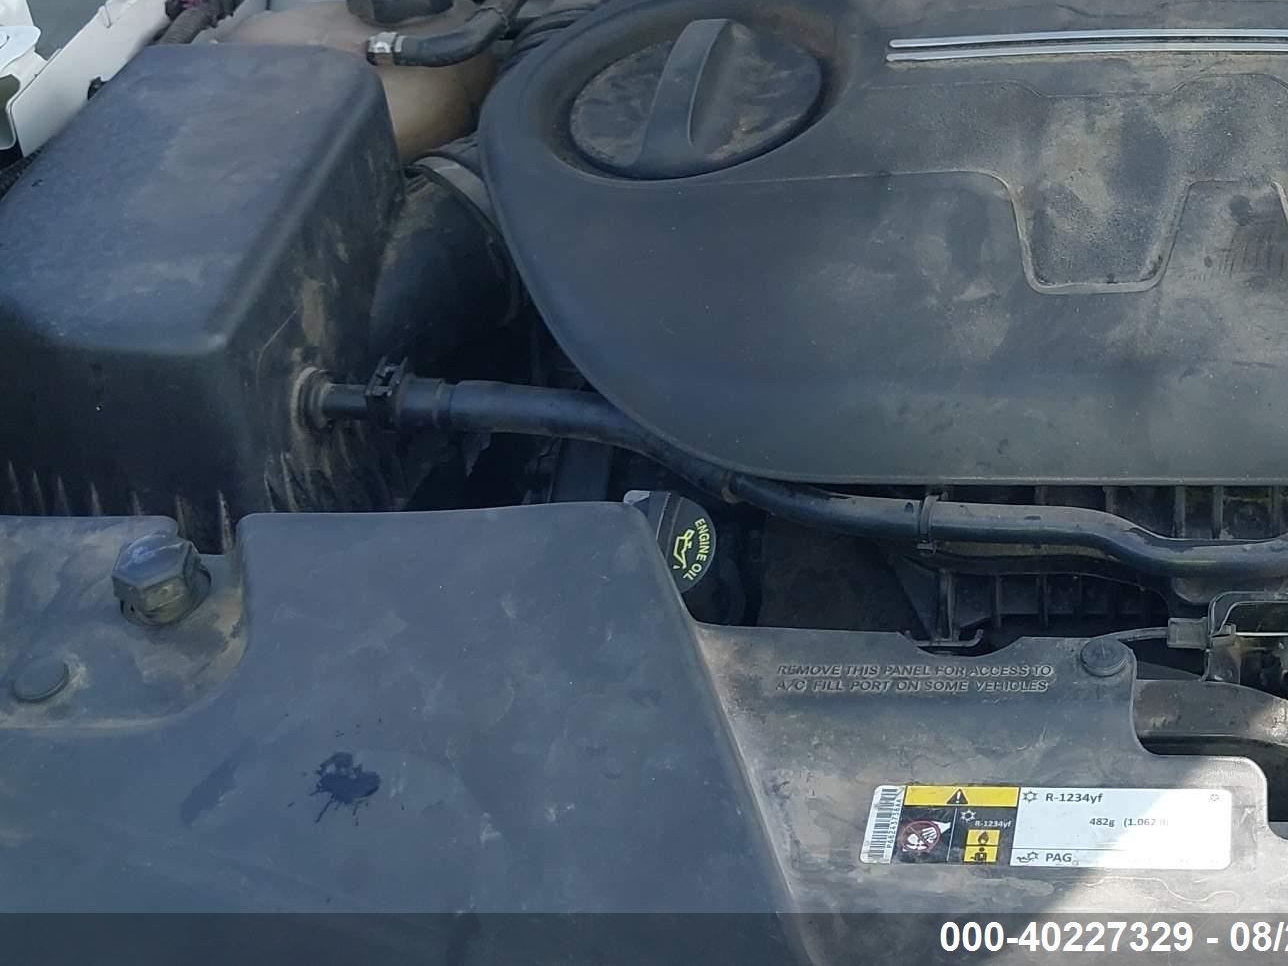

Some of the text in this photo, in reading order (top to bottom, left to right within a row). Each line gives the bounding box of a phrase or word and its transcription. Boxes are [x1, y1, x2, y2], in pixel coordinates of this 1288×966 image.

[682, 517, 711, 581] ENGINE OIL
[776, 664, 1054, 677] REMOVE THIS PANEL FOR ACCESS TO
[775, 679, 1049, 692] A/C FILL PORT ON SOME VEHICLES
[1045, 792, 1104, 804] R-1234yf
[974, 819, 1012, 829] R-1234yf
[1089, 817, 1116, 828] 482g
[1045, 852, 1073, 863] PAG
